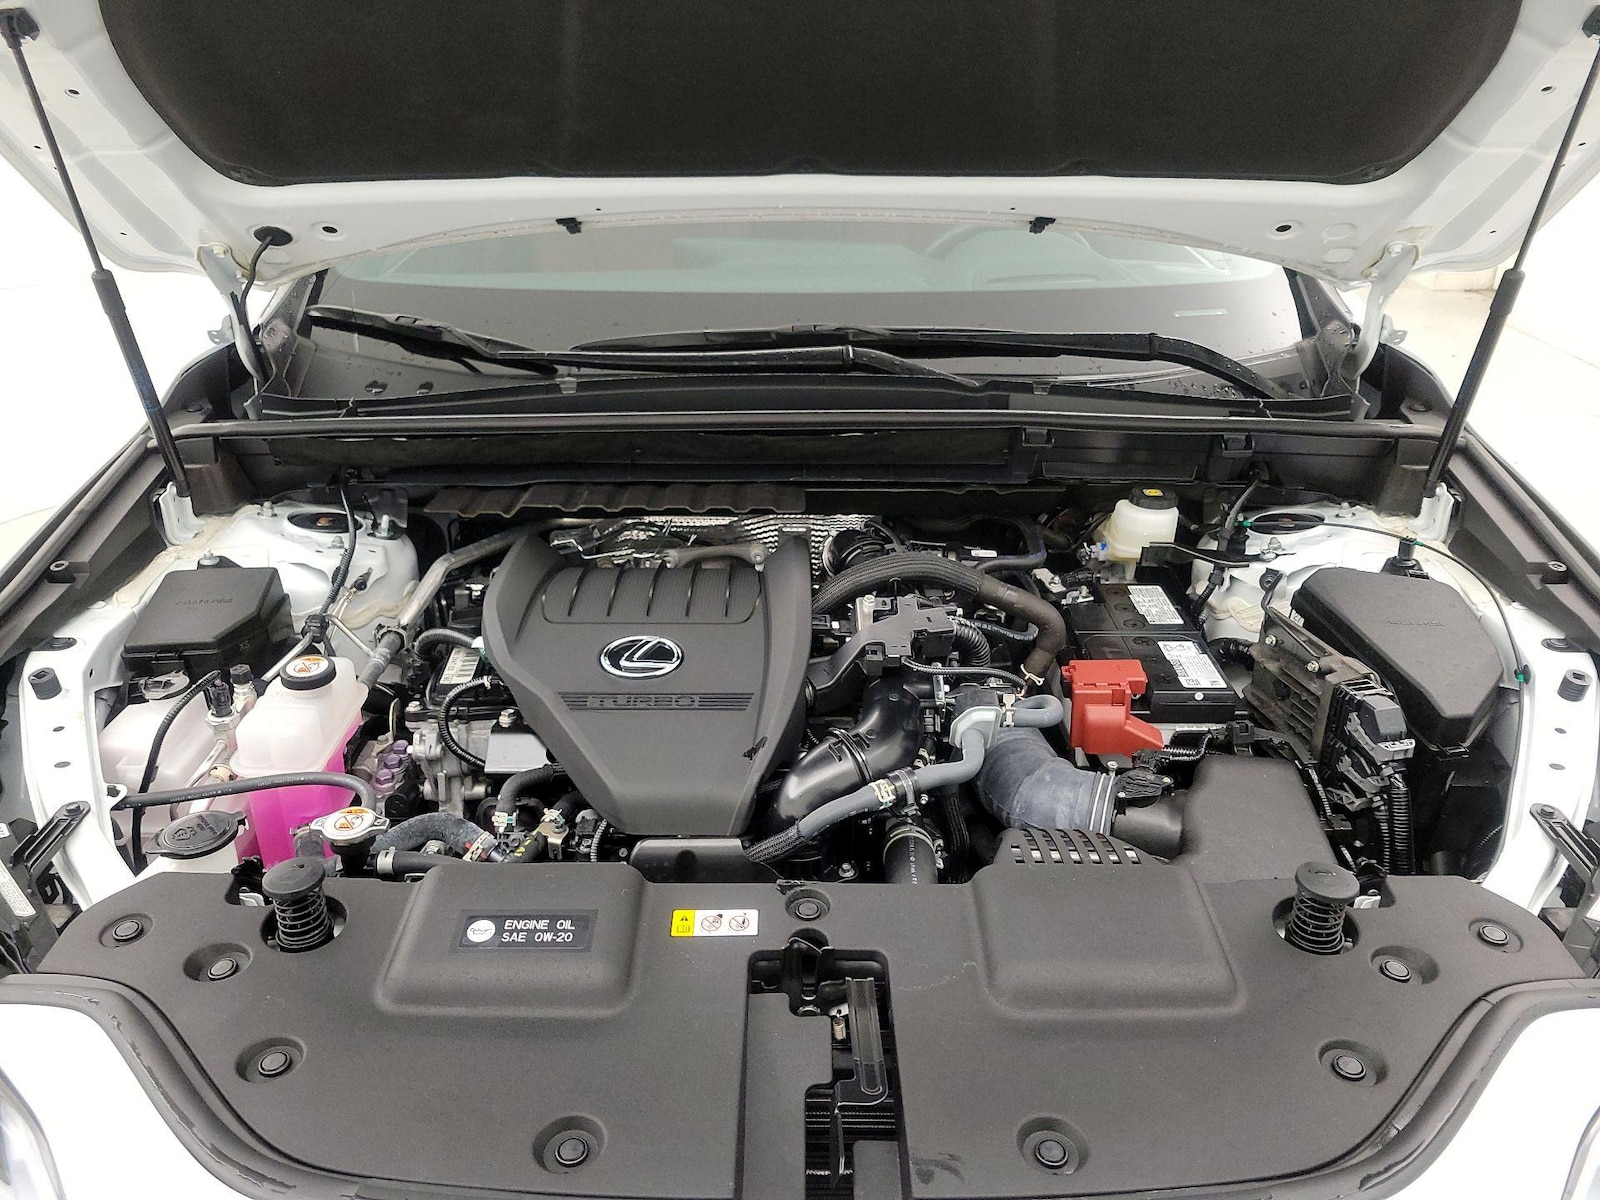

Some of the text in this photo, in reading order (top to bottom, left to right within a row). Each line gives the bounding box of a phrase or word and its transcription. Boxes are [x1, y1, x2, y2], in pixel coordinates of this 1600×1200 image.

[591, 695, 696, 707] TURBO
[503, 919, 576, 930] ENGINE OIL
[501, 931, 574, 942] SAE 0W-20
